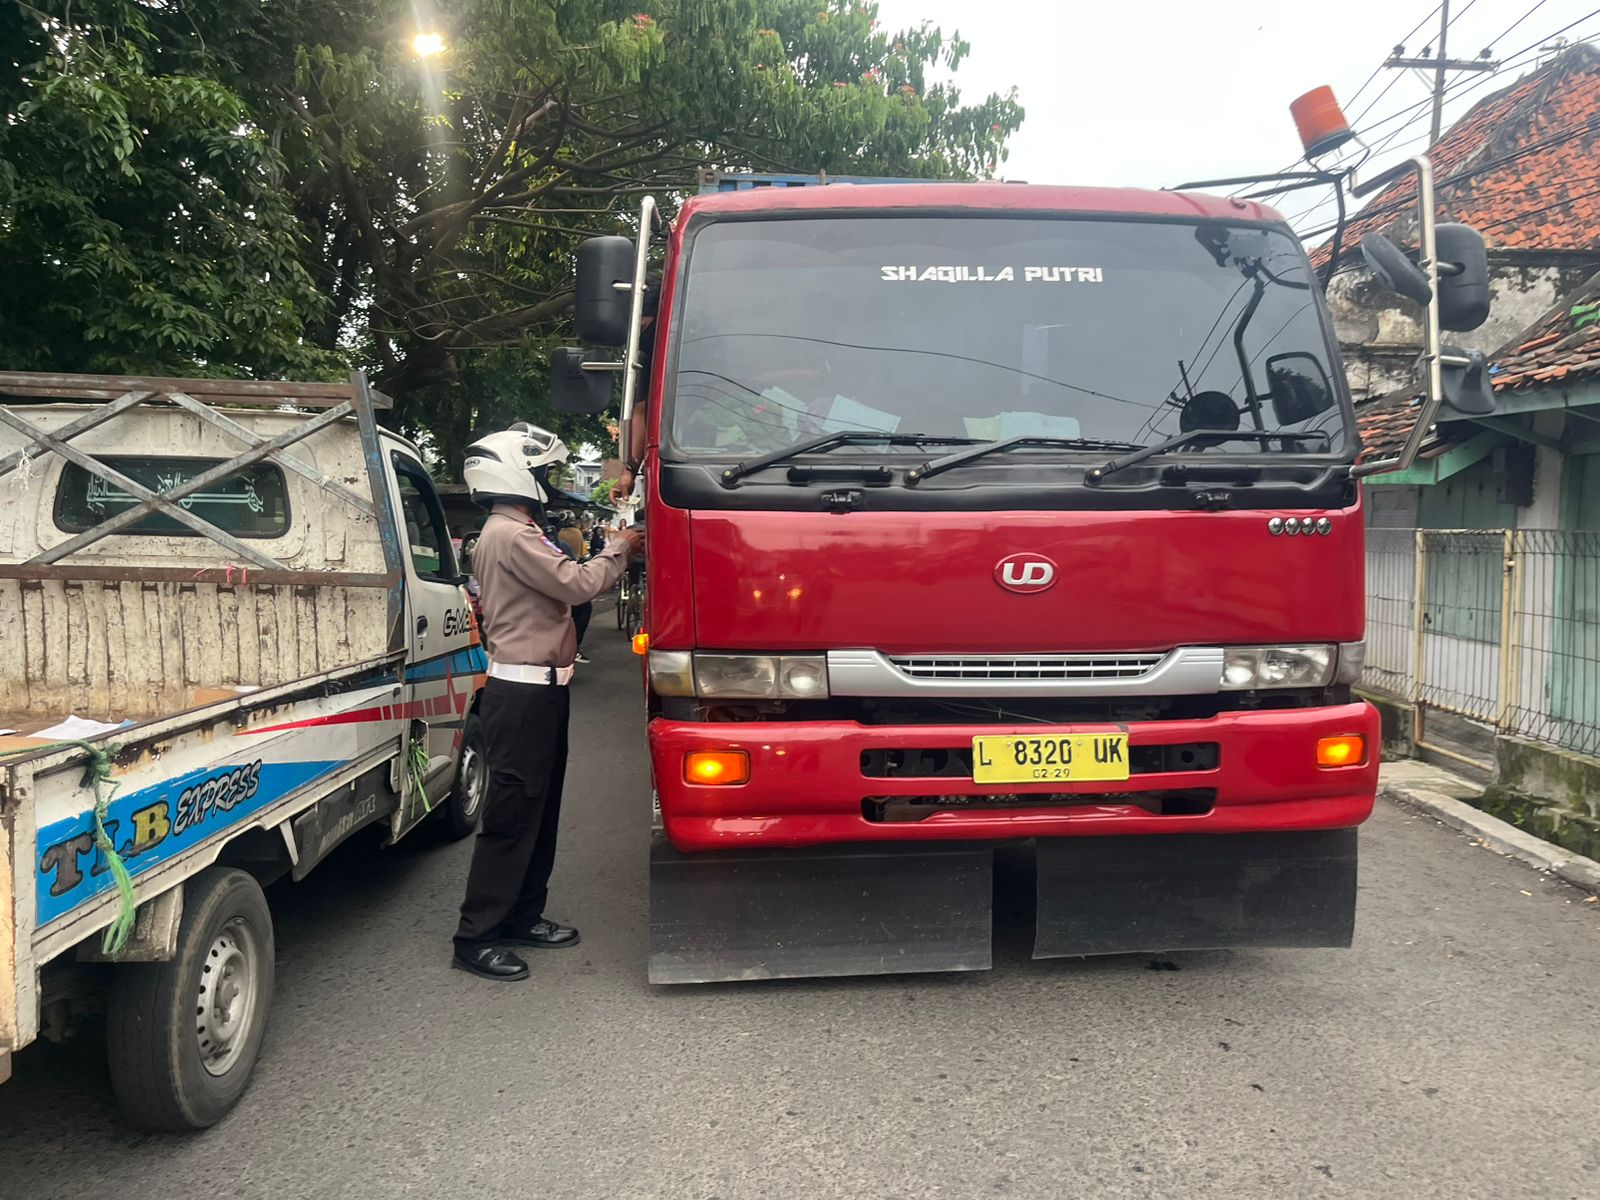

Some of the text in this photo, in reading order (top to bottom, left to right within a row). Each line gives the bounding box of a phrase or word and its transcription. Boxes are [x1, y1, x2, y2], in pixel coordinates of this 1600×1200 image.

[880, 266, 1104, 283] SHAQILLA PUTRI
[1002, 562, 1054, 585] UD
[979, 737, 1122, 766] L 8320 UK
[40, 759, 262, 897] TLB EXPRESS
